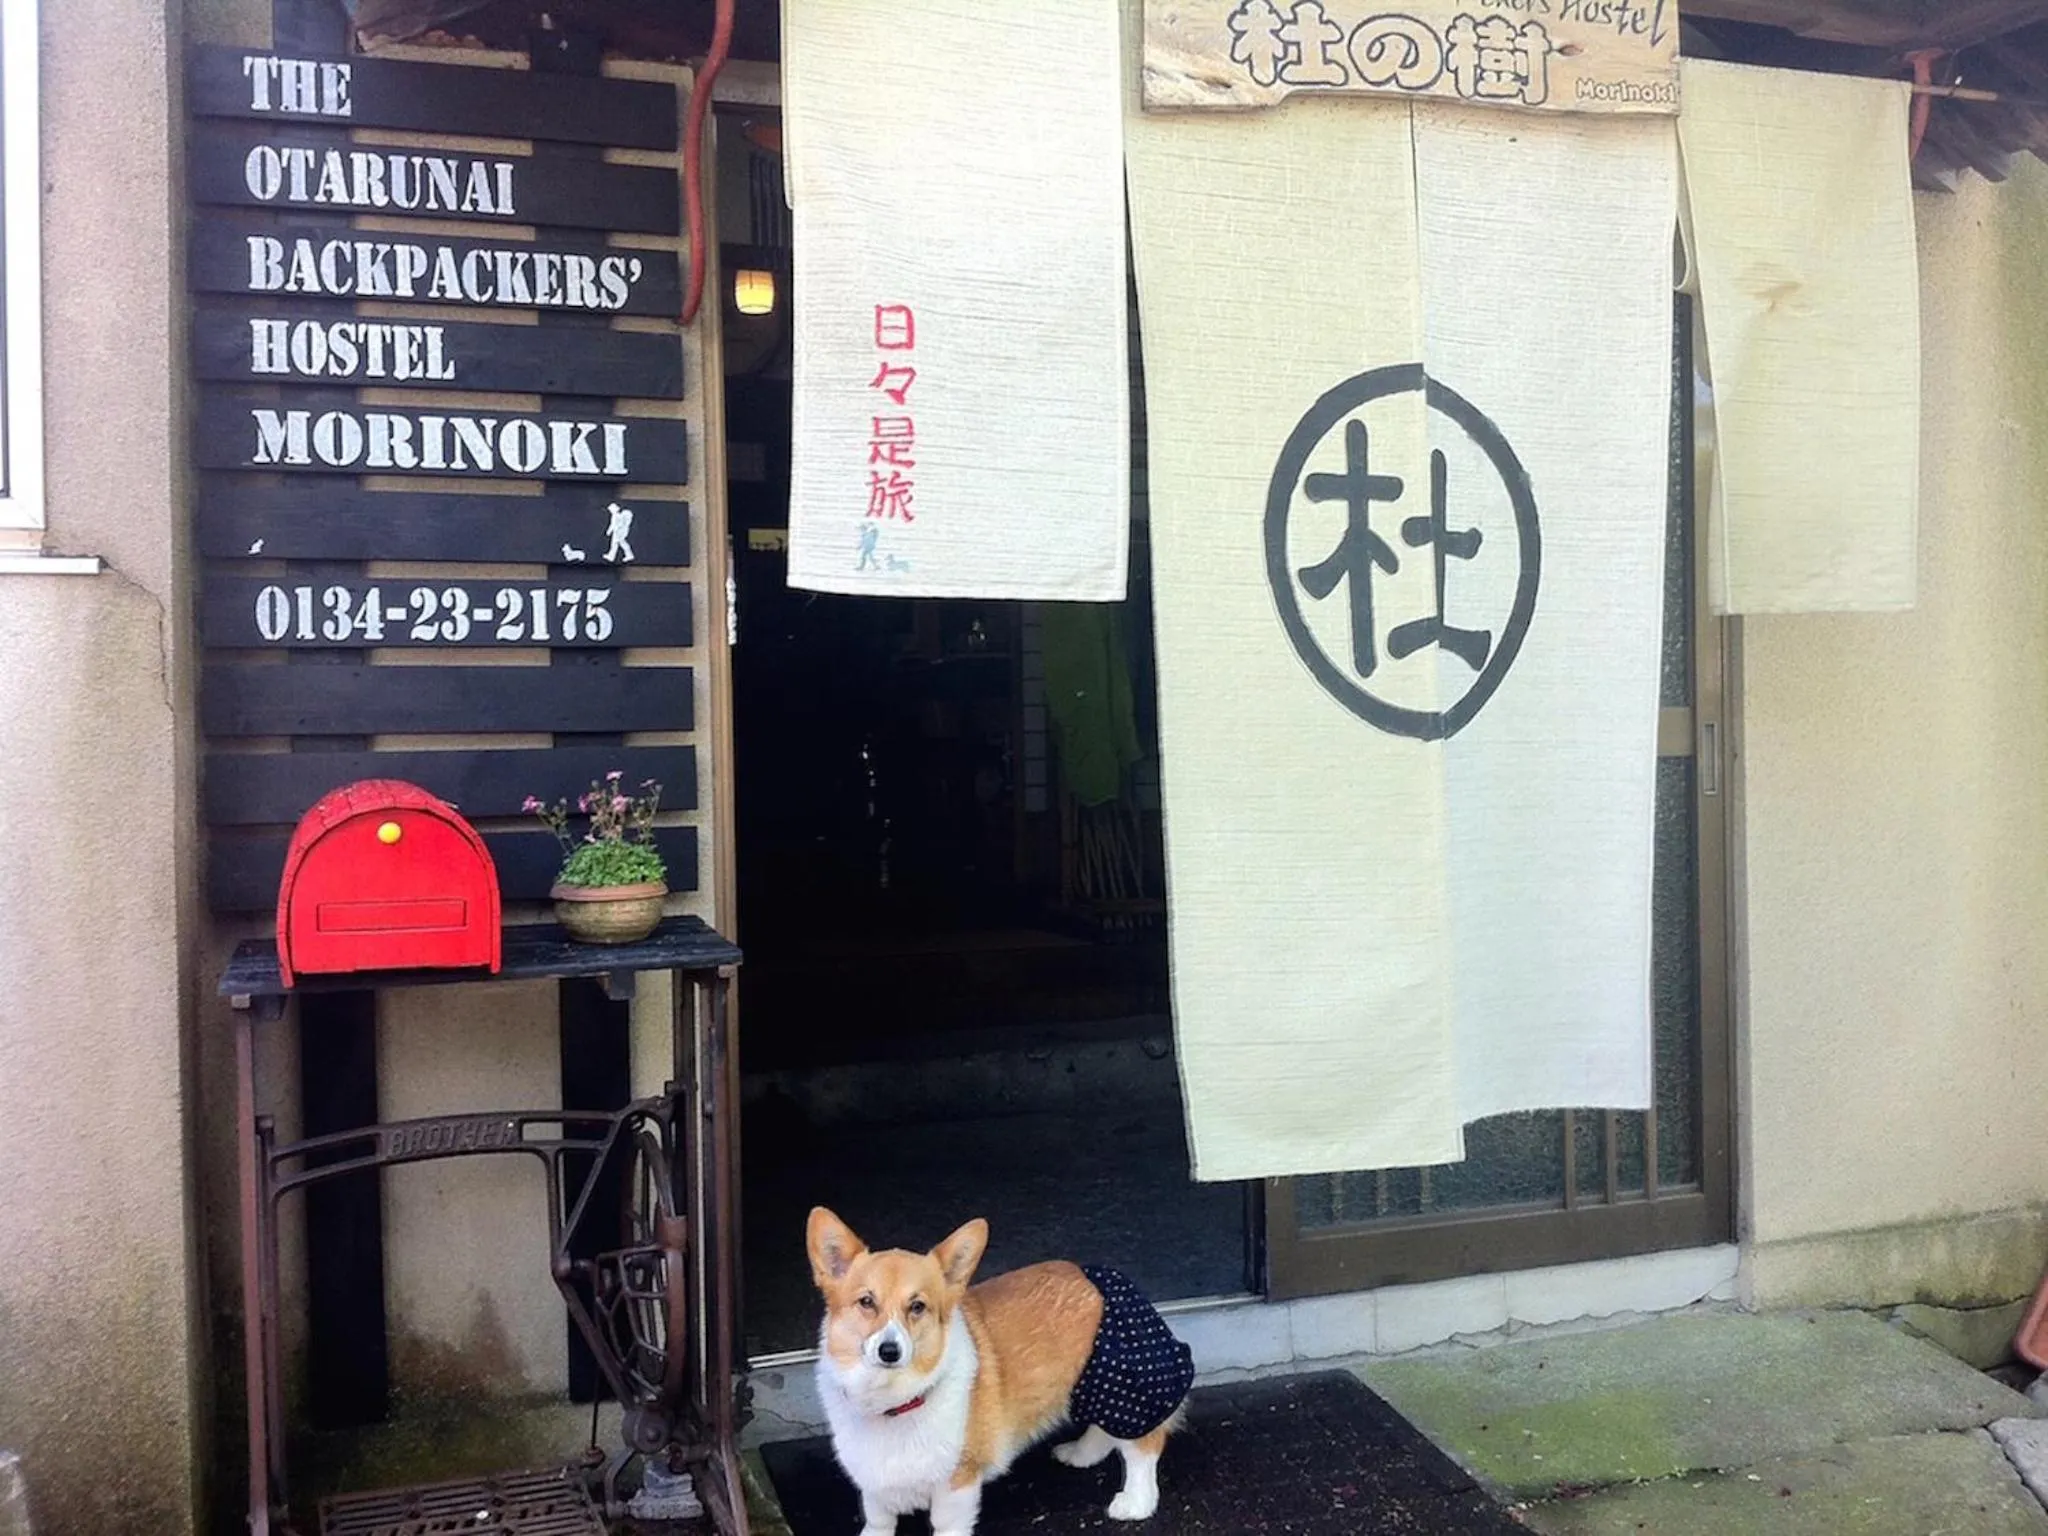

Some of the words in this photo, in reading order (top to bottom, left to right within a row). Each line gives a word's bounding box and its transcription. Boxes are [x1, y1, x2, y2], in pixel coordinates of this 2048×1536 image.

[243, 56, 352, 116] THE
[1228, 0, 1550, 105] 杜の樹
[245, 145, 516, 215] OTARUNAI
[249, 319, 455, 380] HOSTEL
[251, 409, 628, 474] MORINOKI
[865, 304, 917, 523] 日々是旅
[1298, 419, 1492, 678] 杜
[255, 585, 614, 641] 0134-23-2175
